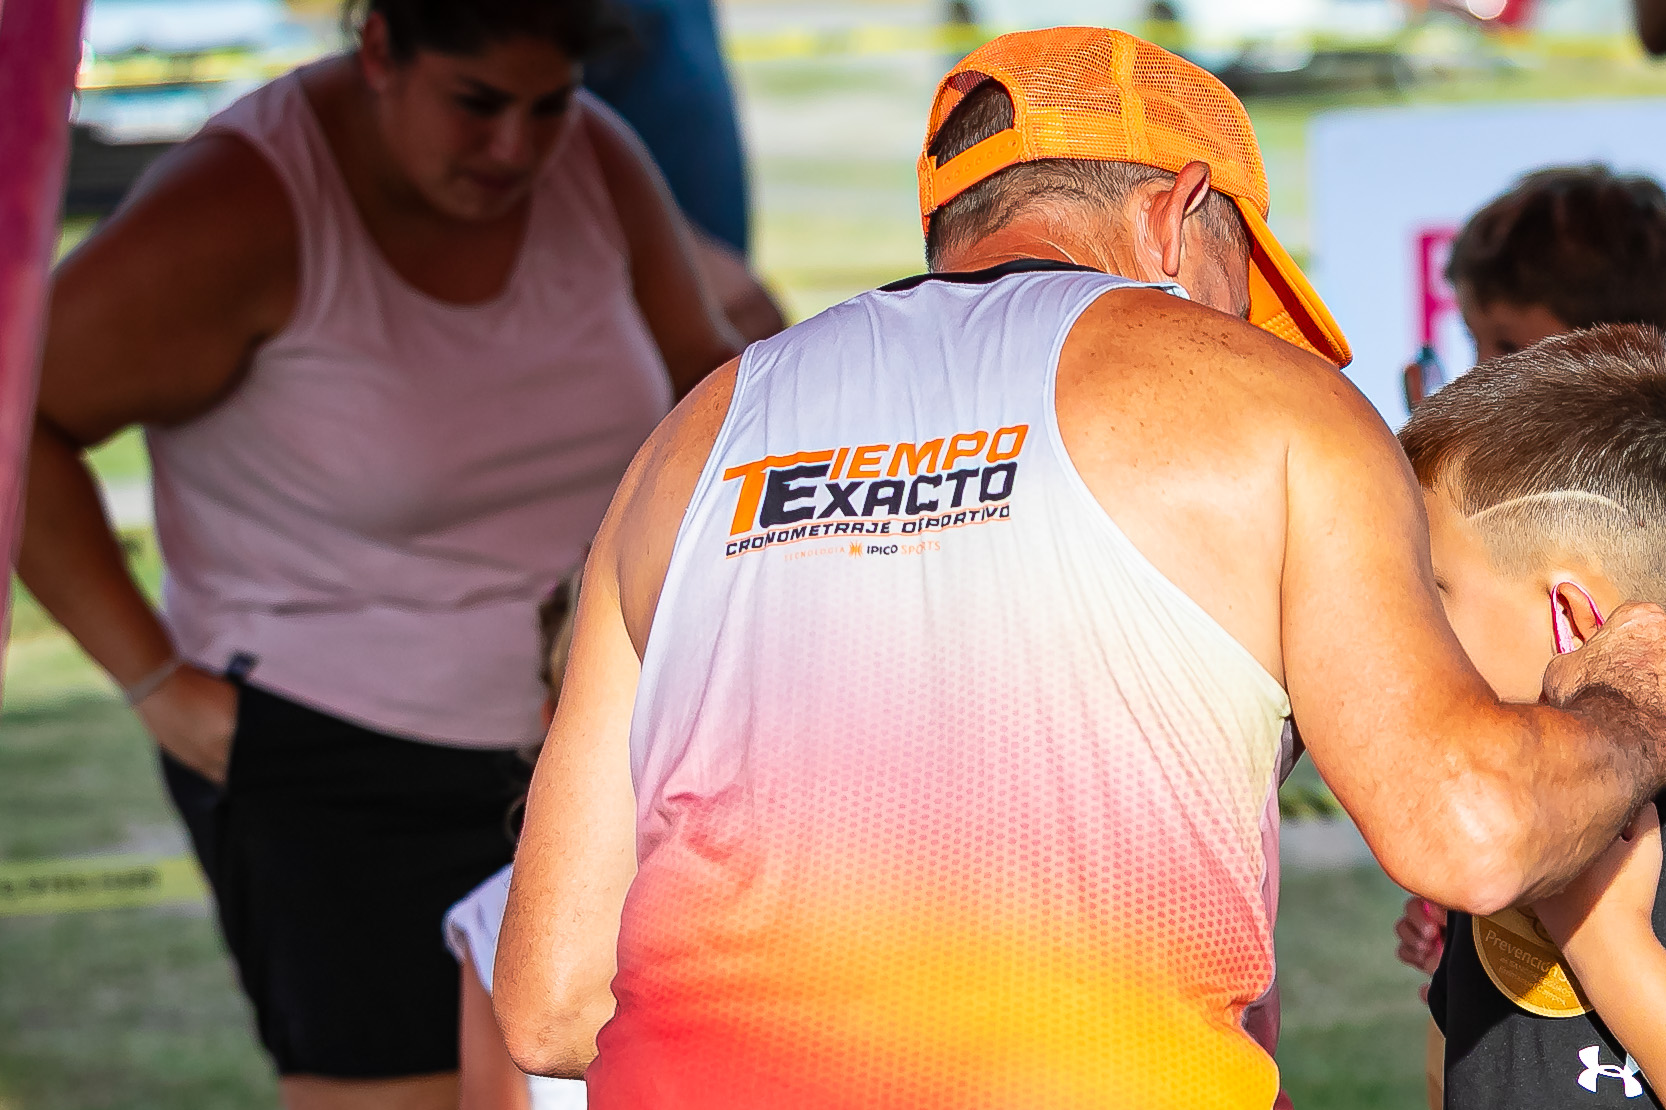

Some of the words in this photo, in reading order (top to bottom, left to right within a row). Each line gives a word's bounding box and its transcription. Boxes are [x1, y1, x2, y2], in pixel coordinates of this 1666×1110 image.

[723, 425, 1029, 536] TIEMPO
[759, 461, 1018, 528] EXACTO
[725, 521, 891, 557] CRONOMETRAJE
[901, 505, 1010, 534] DEPORTIVO
[866, 544, 899, 556] IPICO
[901, 541, 941, 556] SPORTS
